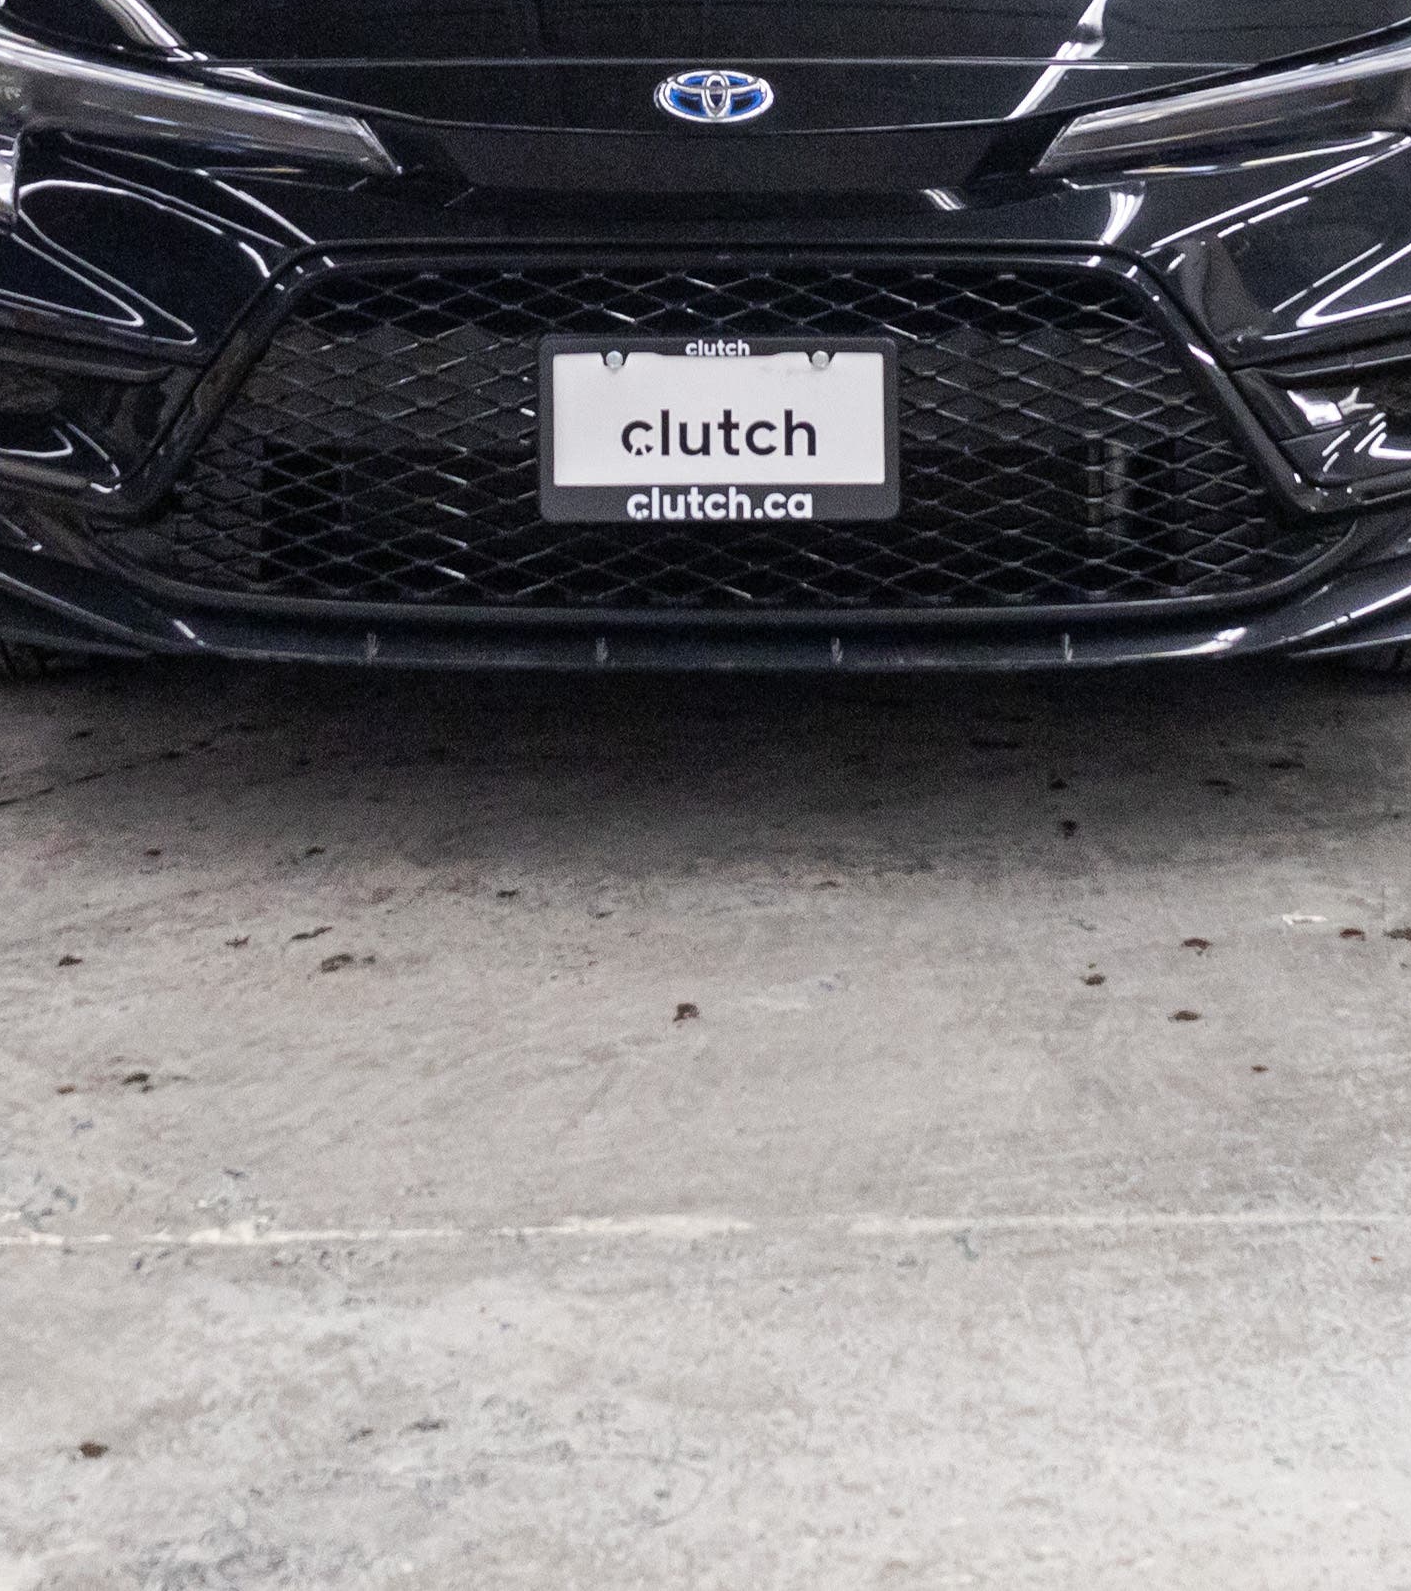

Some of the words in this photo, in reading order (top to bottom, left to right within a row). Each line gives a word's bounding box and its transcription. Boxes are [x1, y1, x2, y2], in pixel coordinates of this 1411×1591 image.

[685, 339, 750, 357] clutch
[621, 409, 817, 456] clutch
[626, 487, 813, 520] clutch.ca
